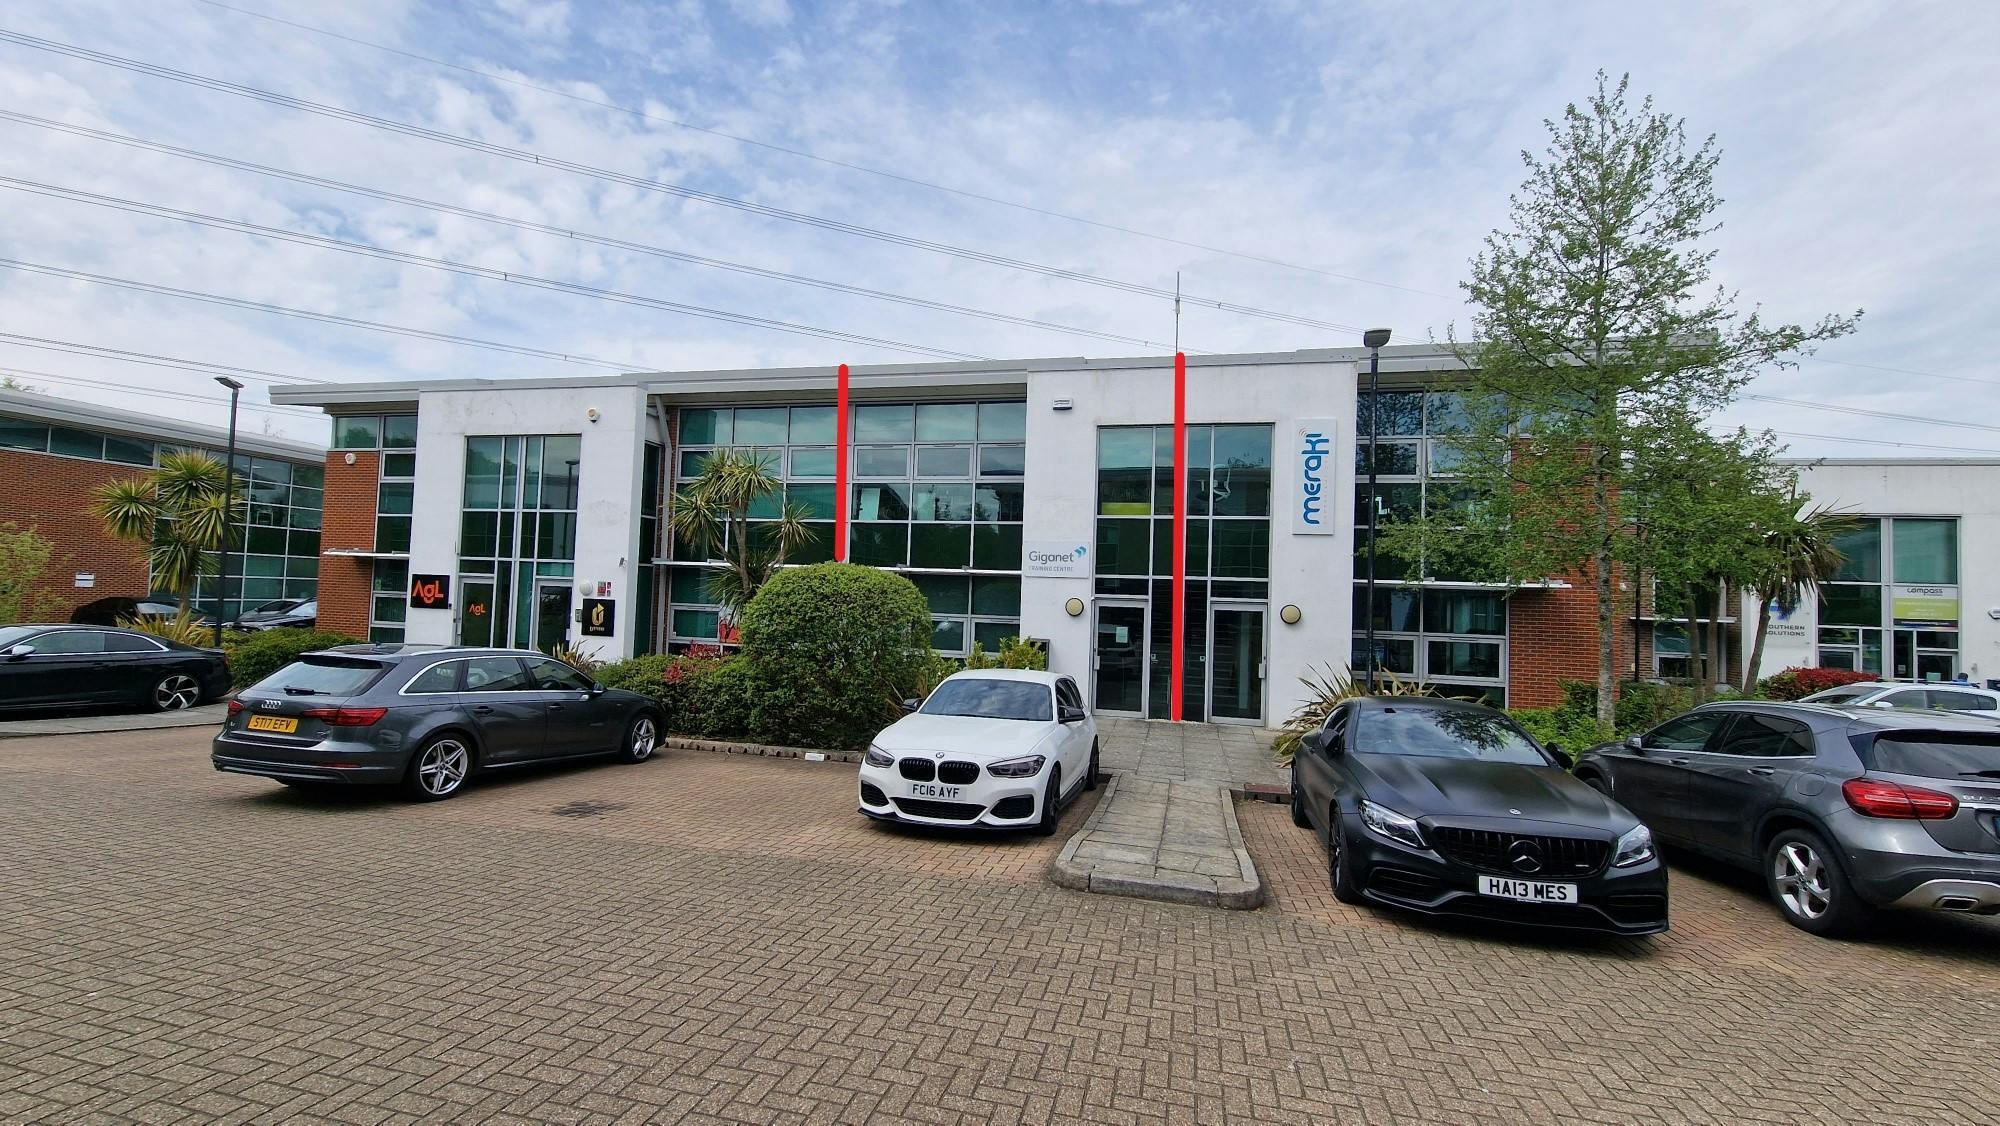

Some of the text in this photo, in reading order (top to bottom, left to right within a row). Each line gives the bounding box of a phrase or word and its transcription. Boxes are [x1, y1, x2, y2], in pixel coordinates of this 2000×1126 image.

[1301, 433, 1329, 525] meraki
[1028, 550, 1074, 565] Giganet
[1906, 587, 1943, 596] compass
[254, 717, 292, 730] ST17 EFV
[912, 784, 960, 798] FC16 AYF
[1489, 878, 1567, 901] HA13 MES
